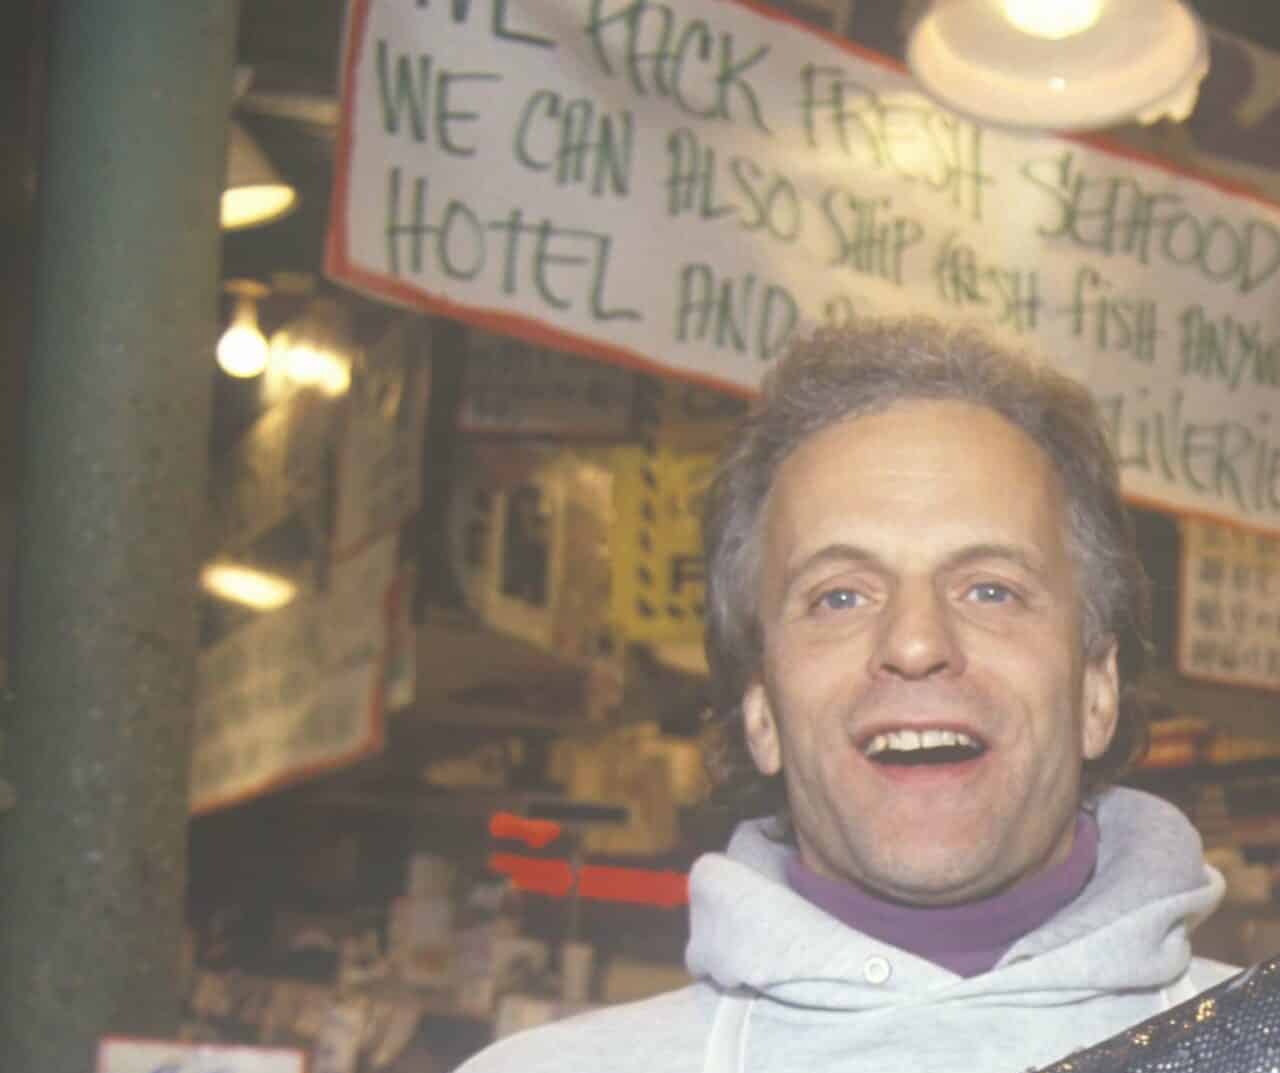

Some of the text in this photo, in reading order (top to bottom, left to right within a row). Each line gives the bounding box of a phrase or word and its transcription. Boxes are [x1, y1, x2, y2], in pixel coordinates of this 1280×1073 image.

[376, 38, 503, 157] WE
[512, 87, 634, 198] CAN
[664, 126, 800, 242] ALSO
[820, 185, 924, 287] SHIP
[586, 0, 772, 134] PACK
[798, 60, 990, 222] FRESH
[386, 166, 800, 363] HOTEL AND
